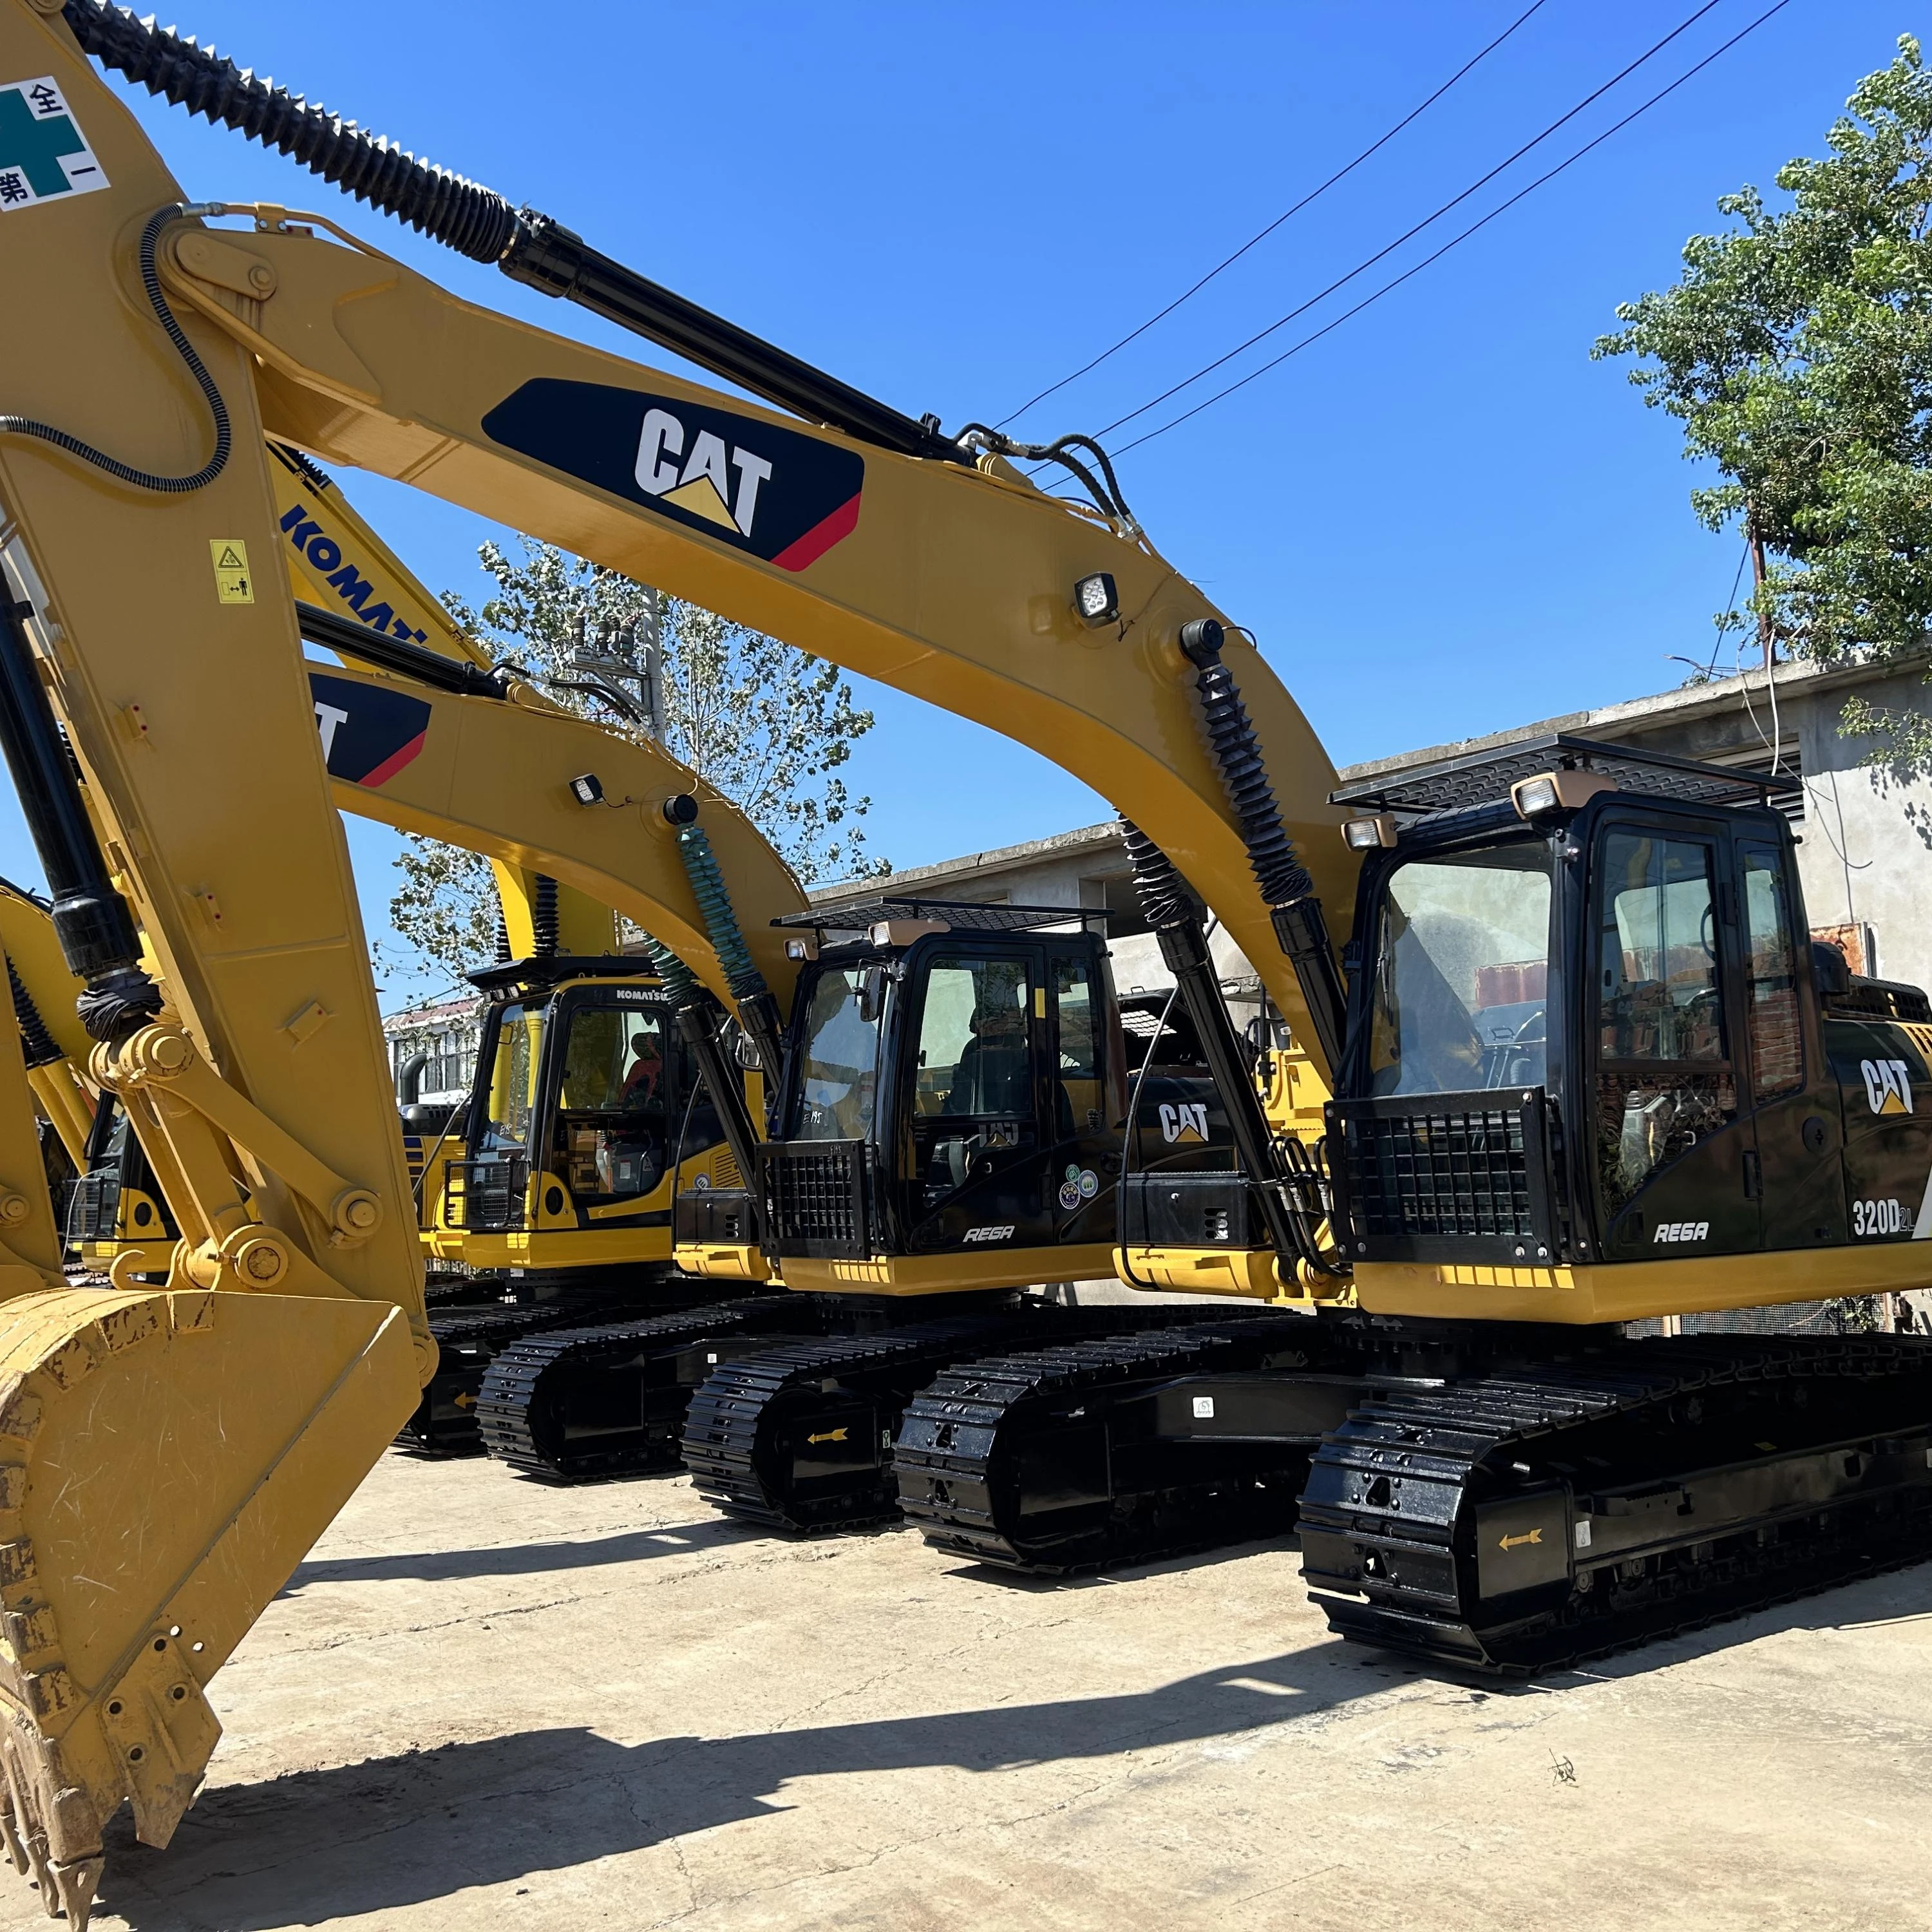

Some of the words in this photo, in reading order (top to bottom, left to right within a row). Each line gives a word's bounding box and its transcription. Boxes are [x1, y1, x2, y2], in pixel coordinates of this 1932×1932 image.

[30, 84, 63, 114] 全
[0, 173, 28, 204] 第
[635, 408, 772, 537] CAT
[1861, 1059, 1913, 1114] CAT
[1159, 1104, 1209, 1142] CAT
[963, 1225, 1015, 1242] REGA
[1653, 1222, 1709, 1243] REGA
